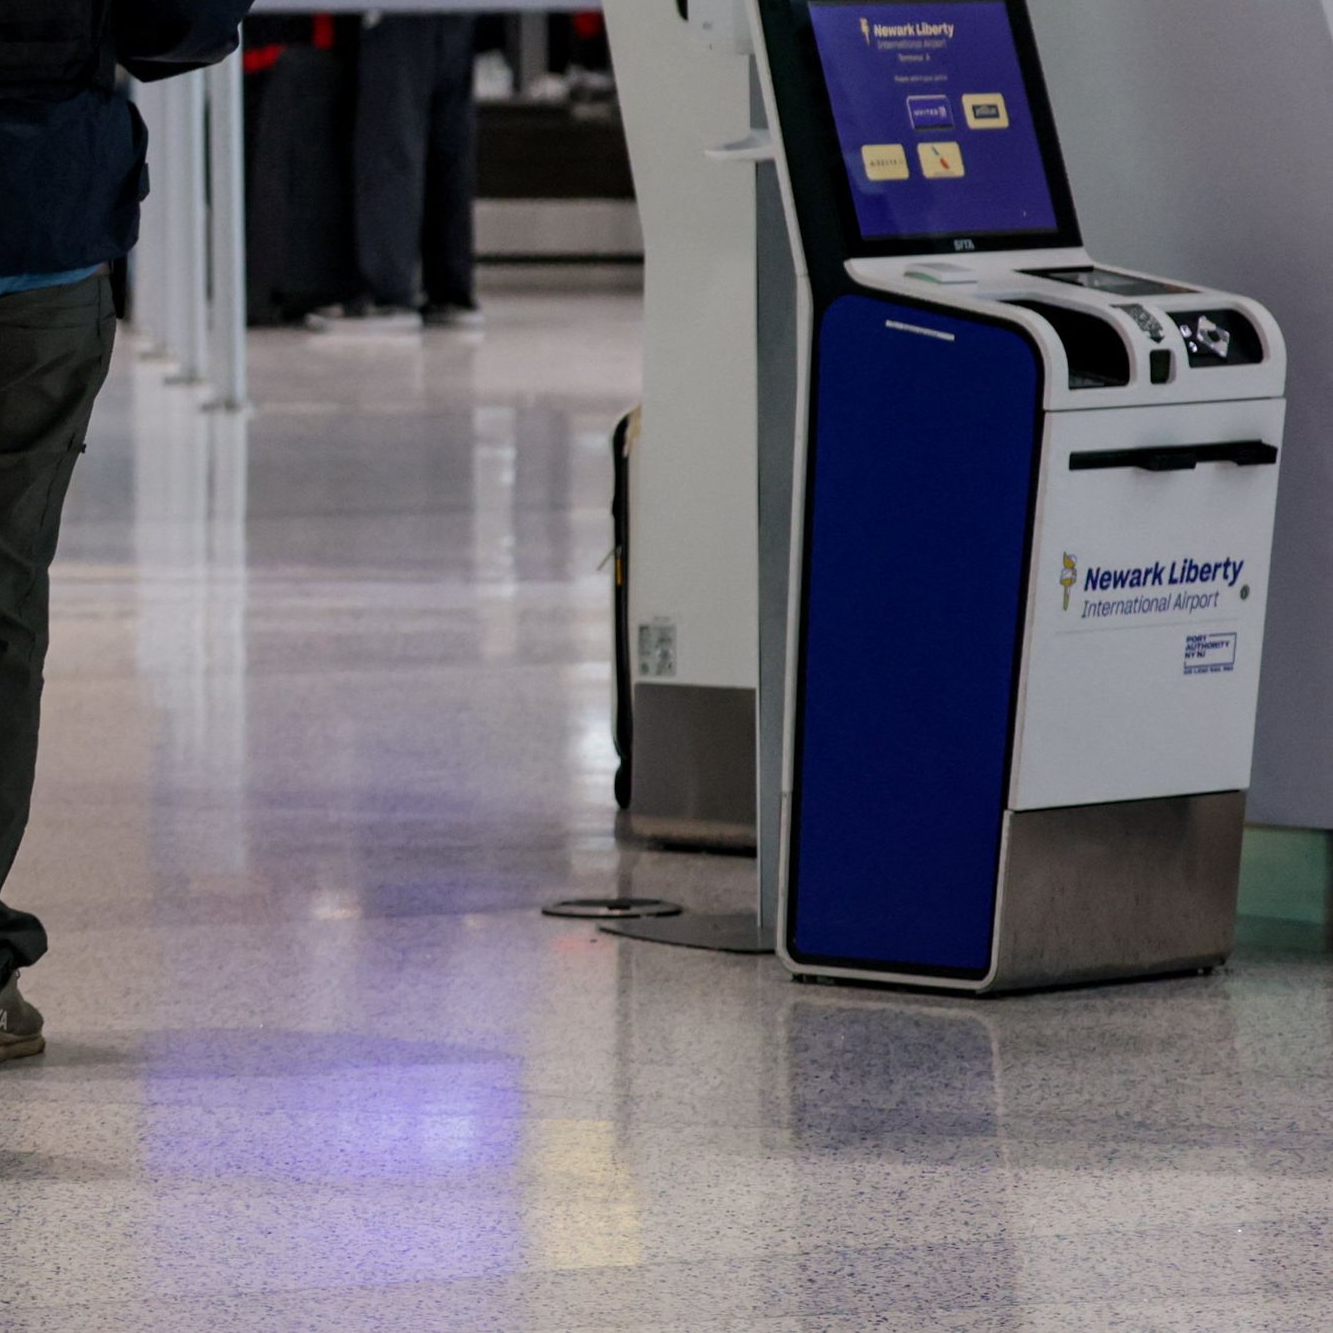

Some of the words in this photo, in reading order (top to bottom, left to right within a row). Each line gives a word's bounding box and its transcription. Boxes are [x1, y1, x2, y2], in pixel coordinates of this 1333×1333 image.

[873, 23, 915, 37] Newark
[916, 22, 954, 39] Liberty
[954, 239, 975, 251] SITA
[1084, 561, 1165, 592] Newark
[1168, 556, 1245, 587] Liberty
[1081, 593, 1172, 618] International
[1173, 590, 1220, 615] Airport
